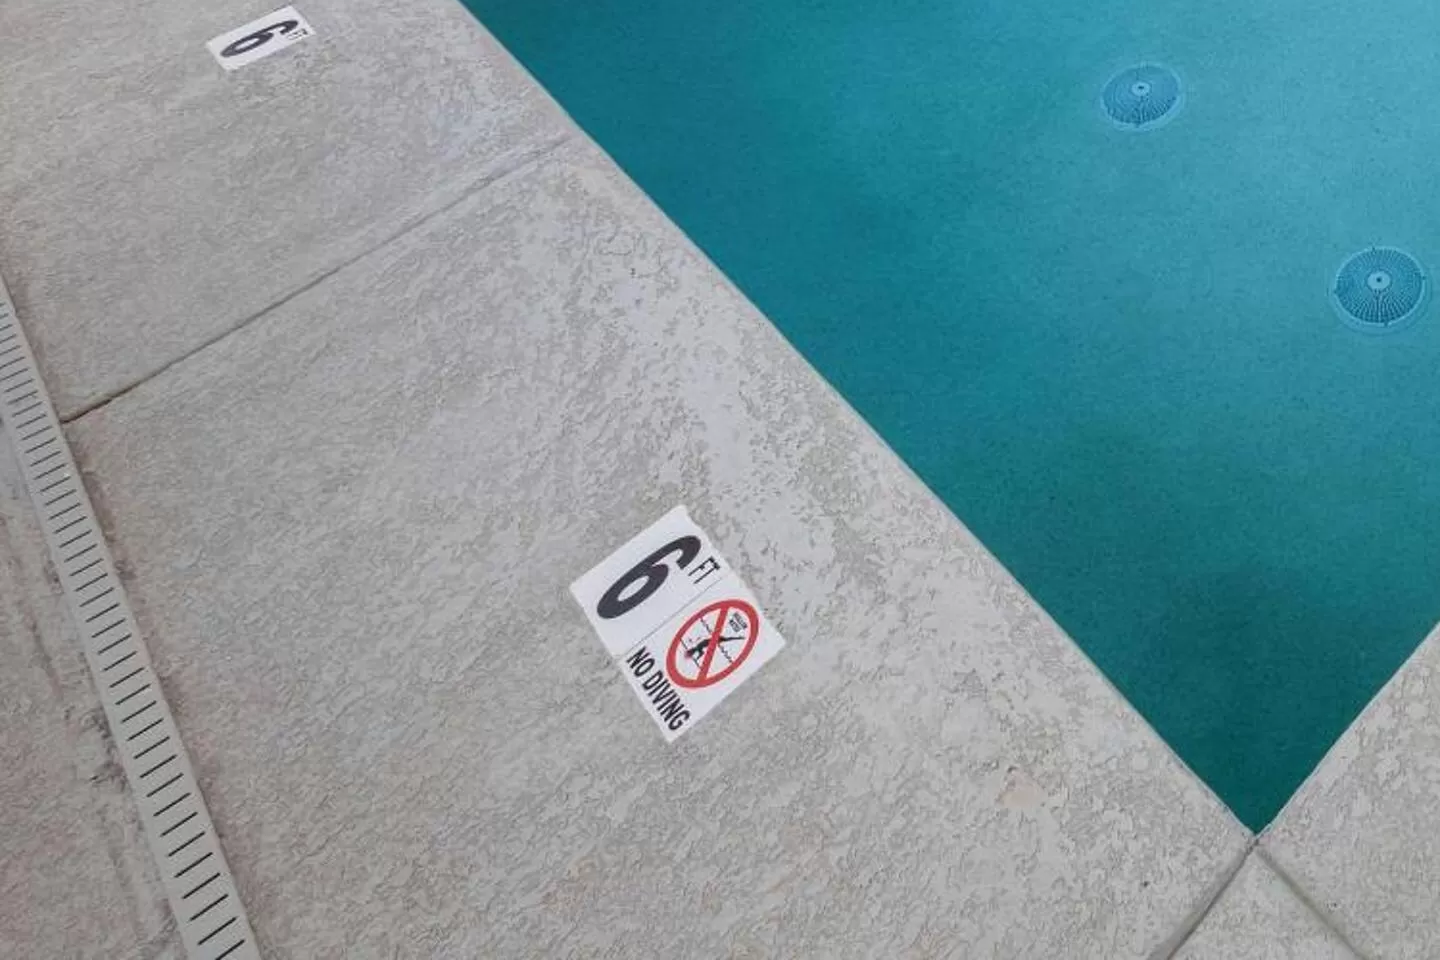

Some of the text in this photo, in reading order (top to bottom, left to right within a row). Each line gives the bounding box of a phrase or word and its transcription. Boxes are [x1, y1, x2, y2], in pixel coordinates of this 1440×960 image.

[220, 20, 299, 58] 6
[597, 535, 720, 619] 6 FT
[626, 646, 691, 731] NO DIVING
